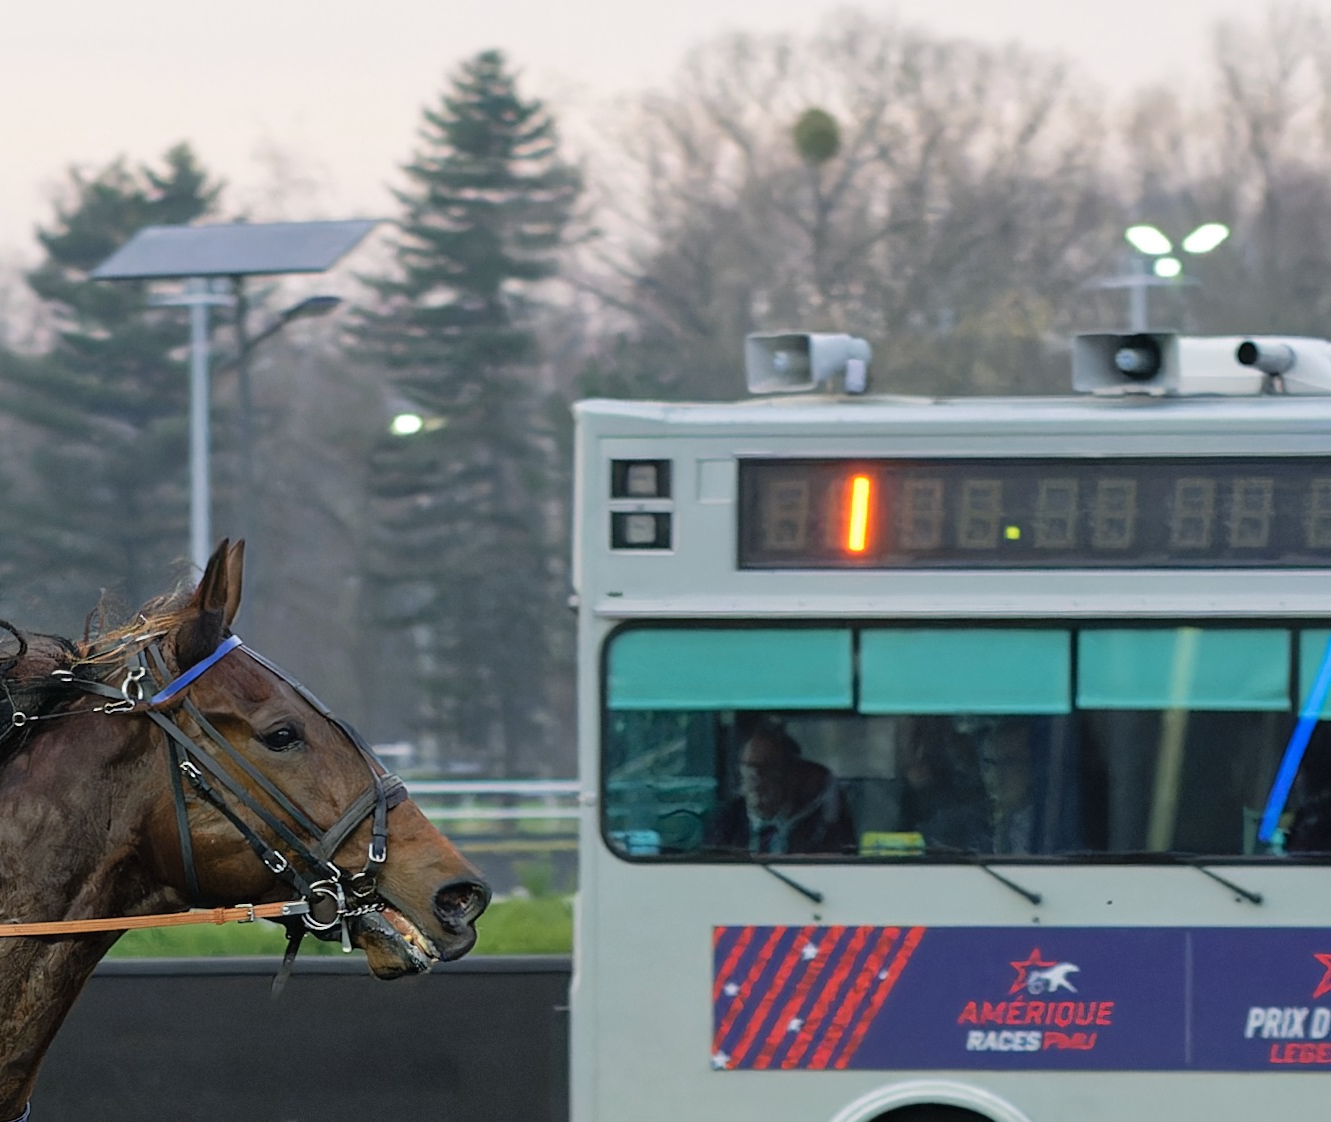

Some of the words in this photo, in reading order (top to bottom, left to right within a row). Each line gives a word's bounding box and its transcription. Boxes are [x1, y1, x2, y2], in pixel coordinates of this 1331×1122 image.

[956, 995, 1116, 1028] AMÉRIQUE
[1244, 1006, 1310, 1039] PRIX
[966, 1030, 1042, 1051] RACES
